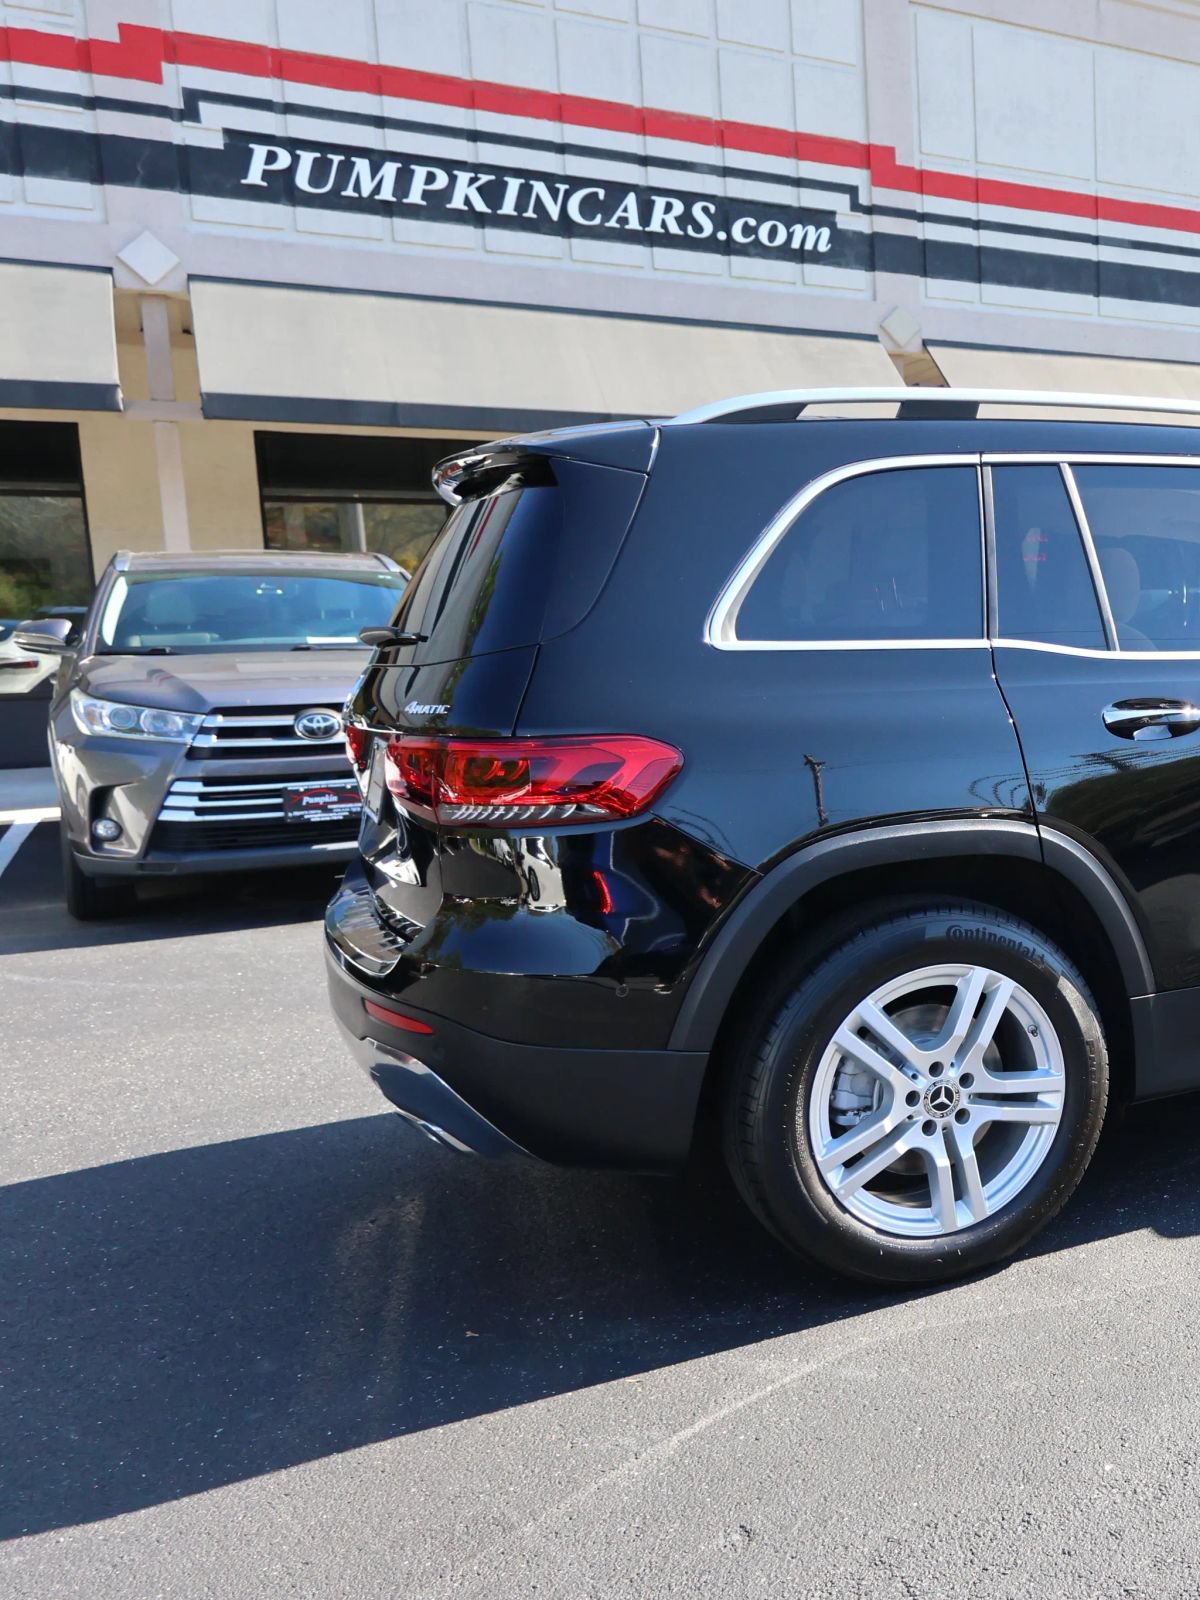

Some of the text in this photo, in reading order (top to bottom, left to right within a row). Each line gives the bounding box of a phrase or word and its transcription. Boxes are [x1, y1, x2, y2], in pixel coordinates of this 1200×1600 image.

[240, 143, 832, 252] PUMPKINCARS.com
[404, 700, 451, 714] 4MATIC
[302, 794, 338, 806] Pumpkin
[946, 924, 1037, 960] Continental
